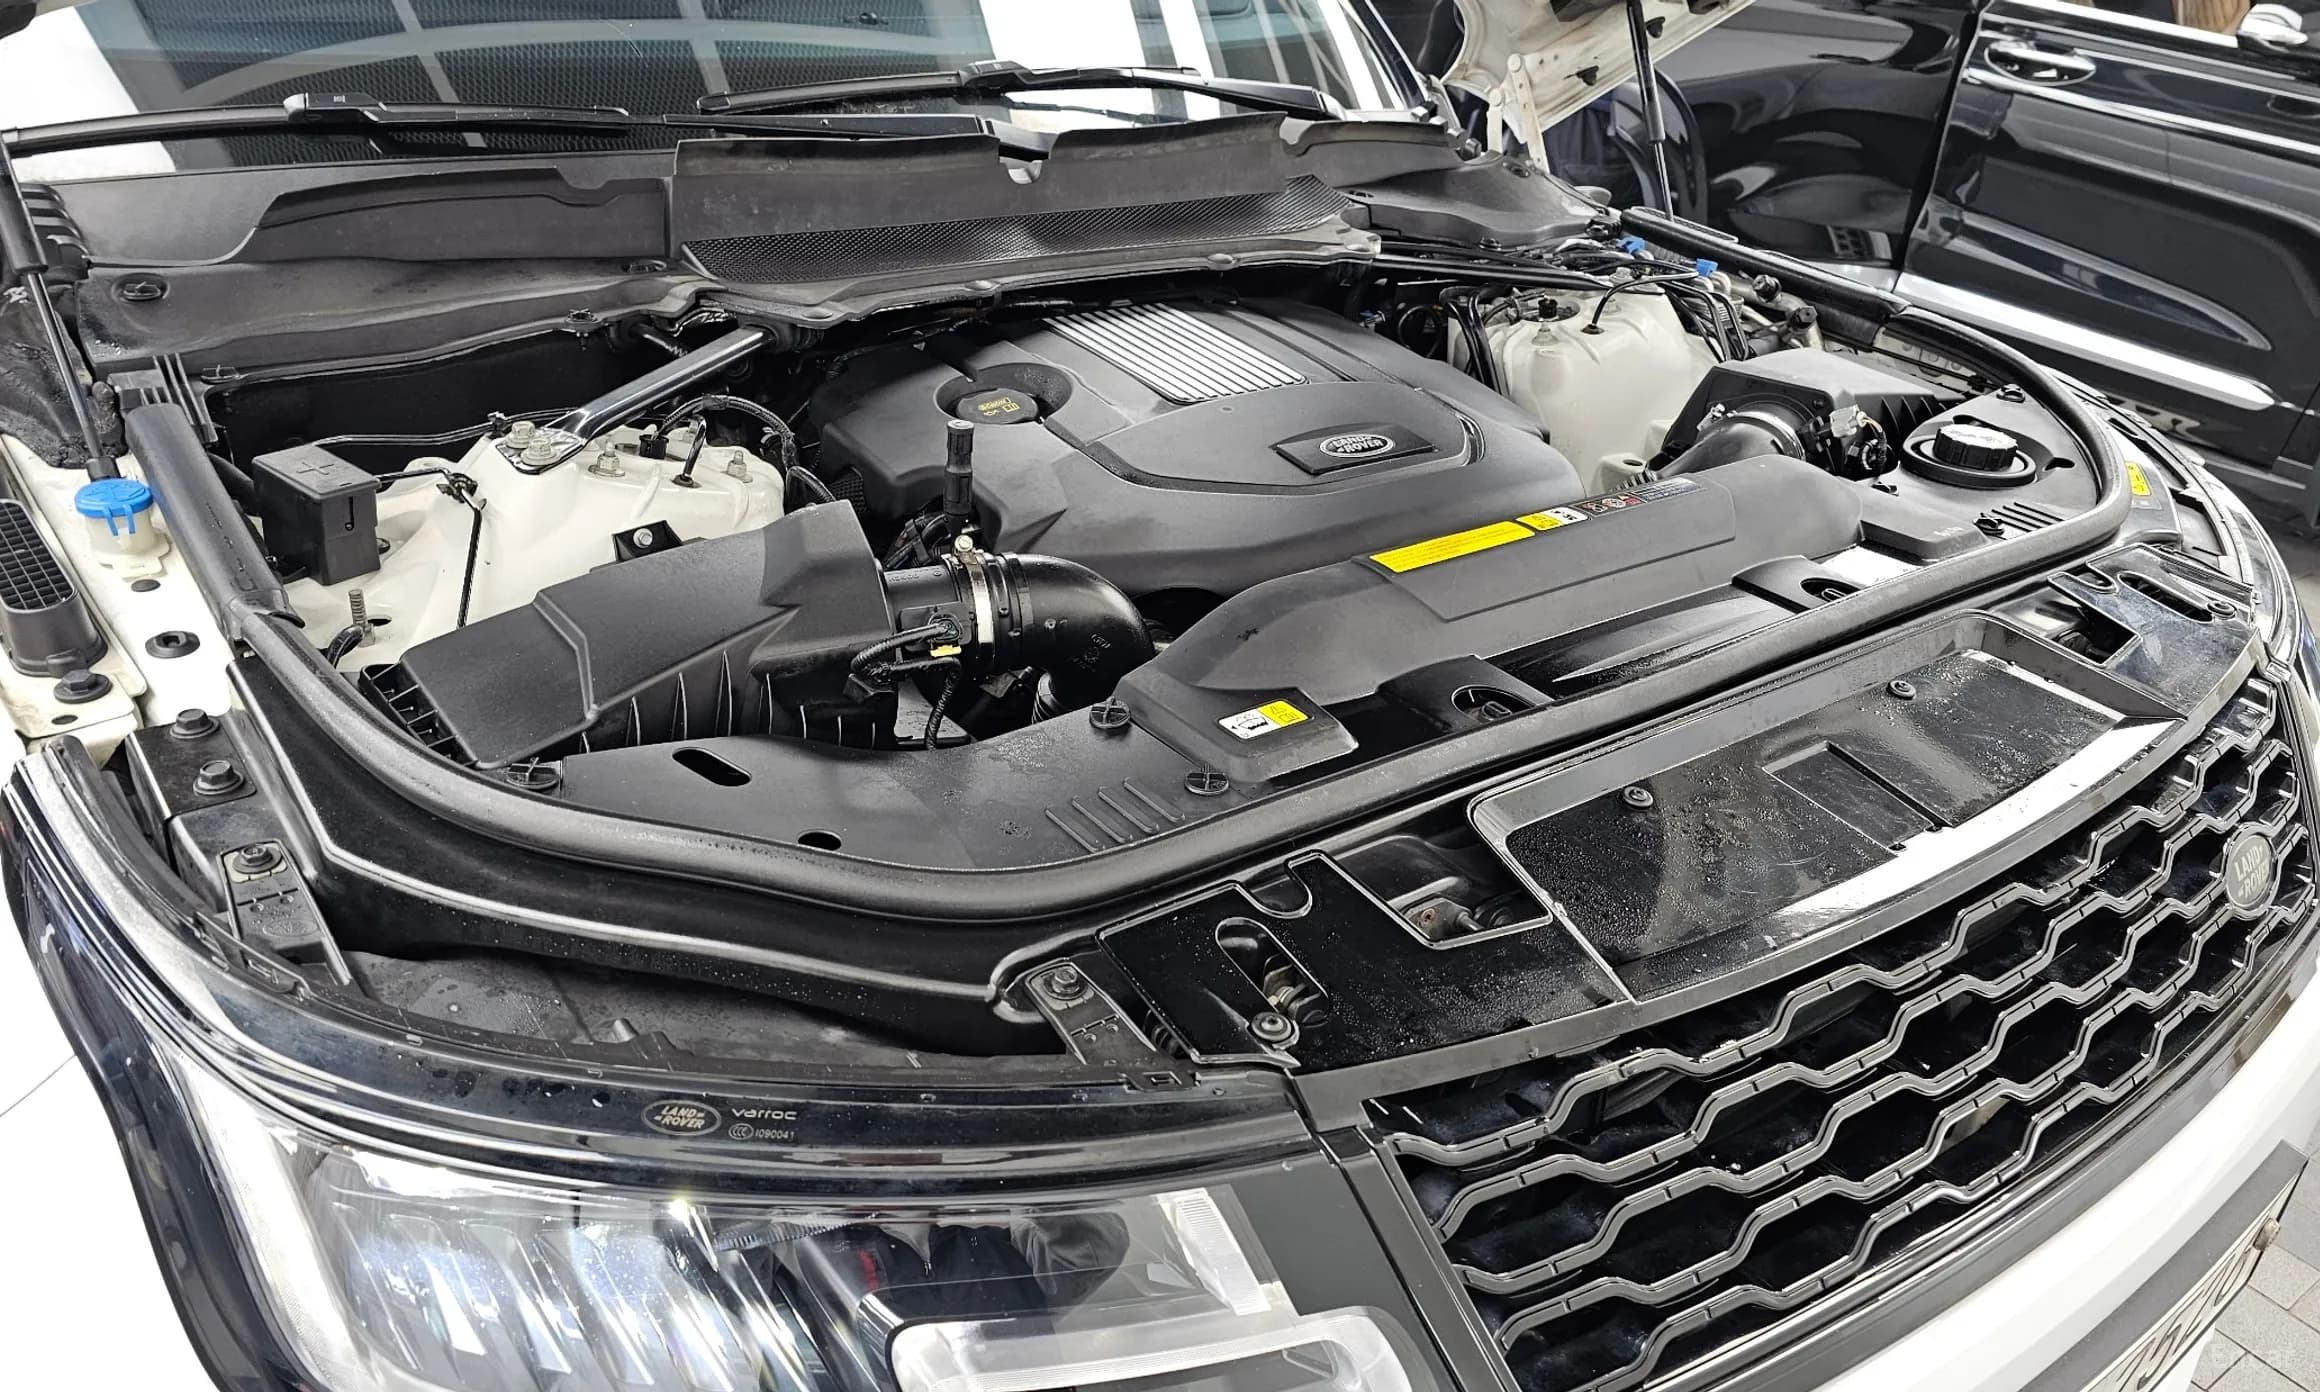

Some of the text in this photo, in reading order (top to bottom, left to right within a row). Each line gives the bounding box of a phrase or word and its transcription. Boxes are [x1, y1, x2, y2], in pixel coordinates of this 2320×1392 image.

[1344, 439, 1384, 453] ROVER
[2235, 845, 2261, 882] LAND
[661, 1105, 697, 1119] LAND
[731, 1107, 798, 1121] varroc
[661, 1115, 705, 1129] ROVER
